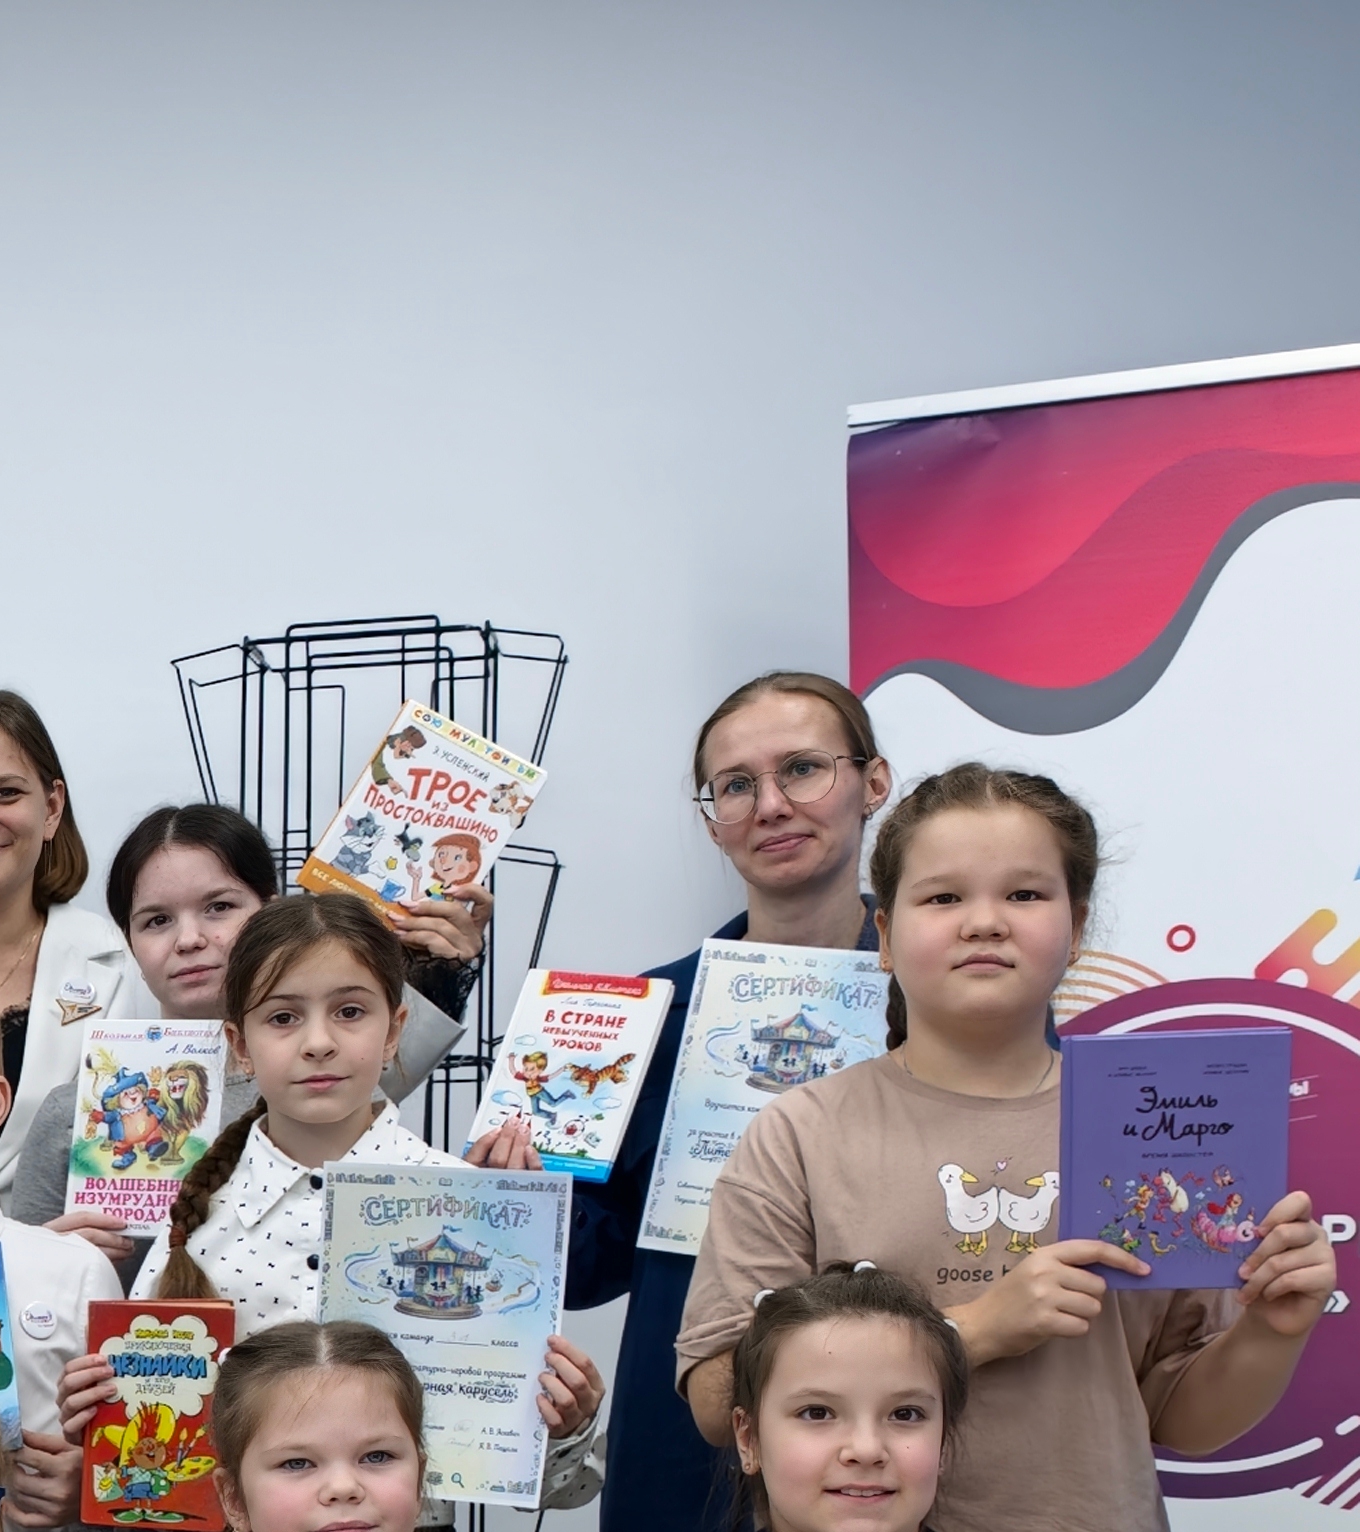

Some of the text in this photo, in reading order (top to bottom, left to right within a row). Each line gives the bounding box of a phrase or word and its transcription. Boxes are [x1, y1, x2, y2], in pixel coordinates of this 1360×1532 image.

[441, 751, 491, 783] УСПЕНСКИЙ
[407, 768, 488, 814] ТРОЕ
[363, 784, 499, 844] ПРОСТОКВАШИНО
[431, 800, 449, 813] ИЗ
[733, 975, 880, 1009] СЕРТИФИКАТ
[544, 1010, 628, 1029] В СТРАНЕ
[542, 1026, 620, 1041] НЕВЫУЧЕННЫХ
[166, 1044, 222, 1055] А. Волков
[552, 1038, 603, 1052] УРОКОВ
[1135, 1085, 1219, 1114] Эмиль
[1123, 1111, 1235, 1147] и Марго
[85, 1177, 182, 1192] ВОЛШЕБНИ
[74, 1192, 178, 1208] ИЗУМРУДНО
[365, 1196, 528, 1228] СЕРТИФИКАТ
[936, 1266, 994, 1285] goose
[124, 1341, 192, 1353] ПРИКЛЮЧЕНИЯ
[109, 1352, 207, 1380] НЕЗНАЙКИ
[412, 1365, 482, 1377] ратурно-игровой
[135, 1383, 177, 1396] ДРУЗЕЙ
[459, 1382, 514, 1400] карусель
